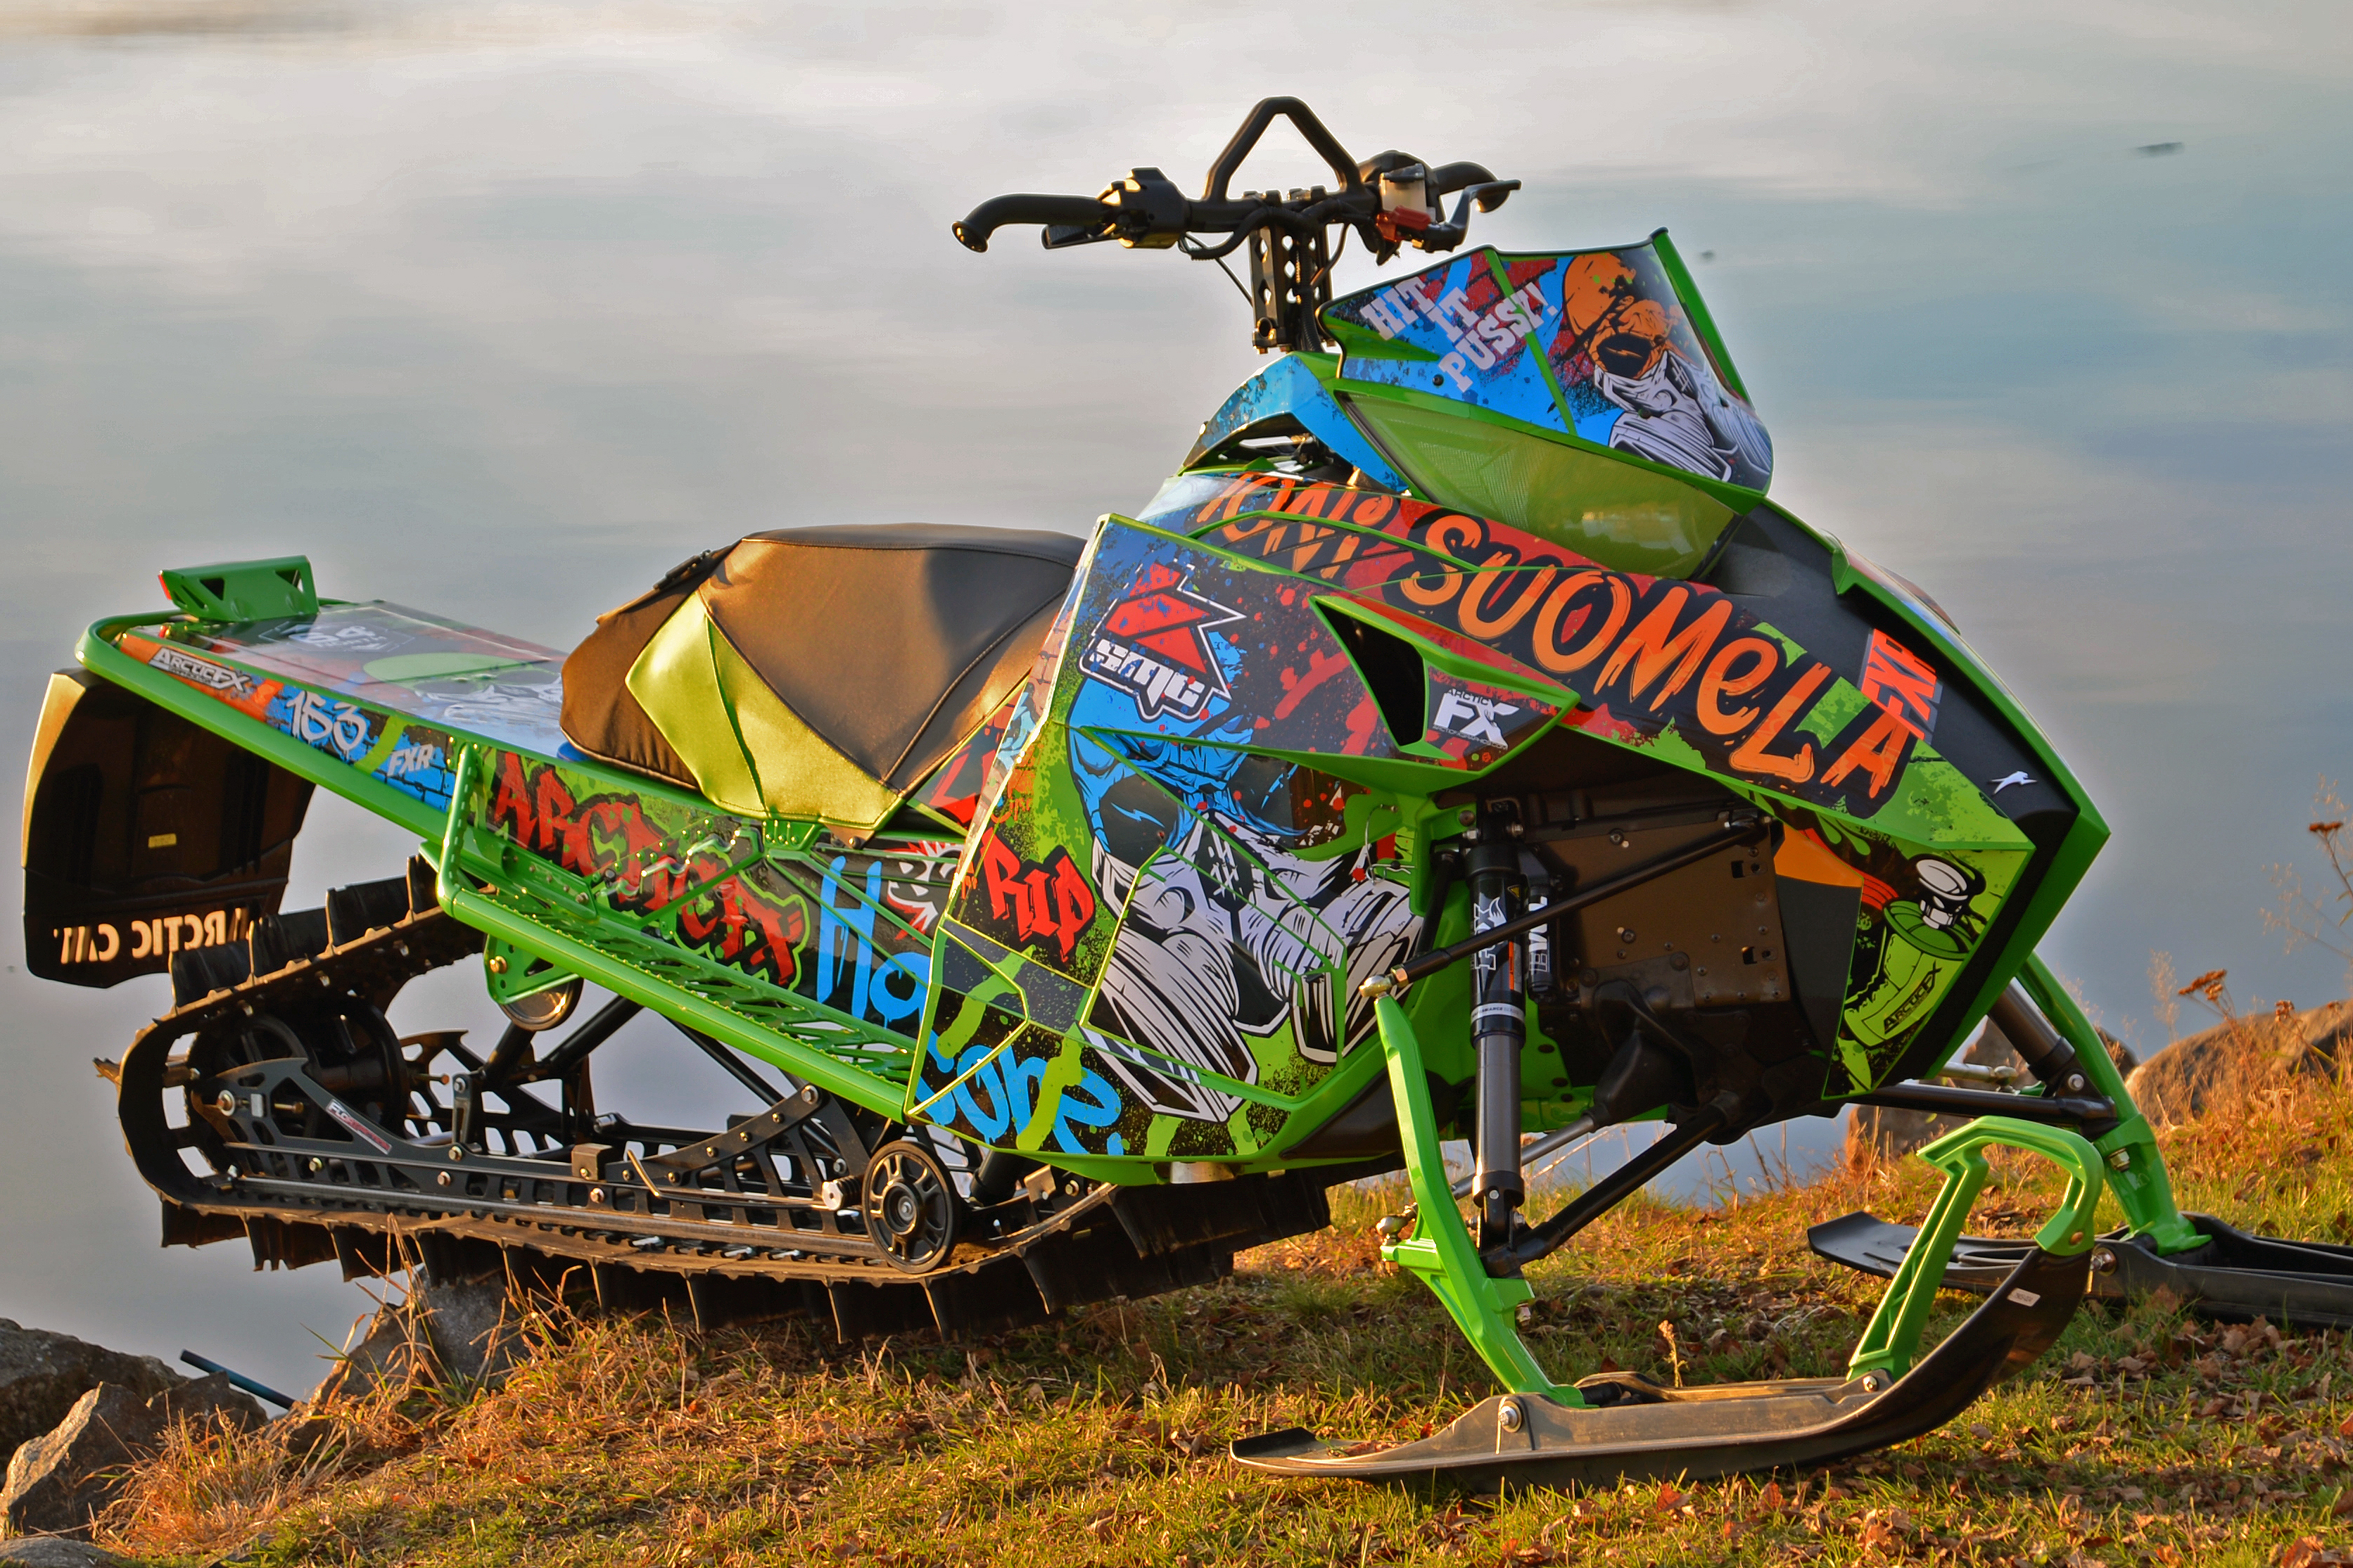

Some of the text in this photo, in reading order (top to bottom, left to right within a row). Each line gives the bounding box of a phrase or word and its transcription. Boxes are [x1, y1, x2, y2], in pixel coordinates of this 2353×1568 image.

[1360, 276, 1435, 340] HIT
[1427, 286, 1479, 343] IT
[1438, 281, 1559, 393] PUSSY!
[1433, 692, 1520, 750] FX
[1447, 688, 1491, 706] ARCTIC
[388, 744, 433, 777] FXR
[979, 827, 1095, 964] RIP
[1473, 896, 1507, 971] FX
